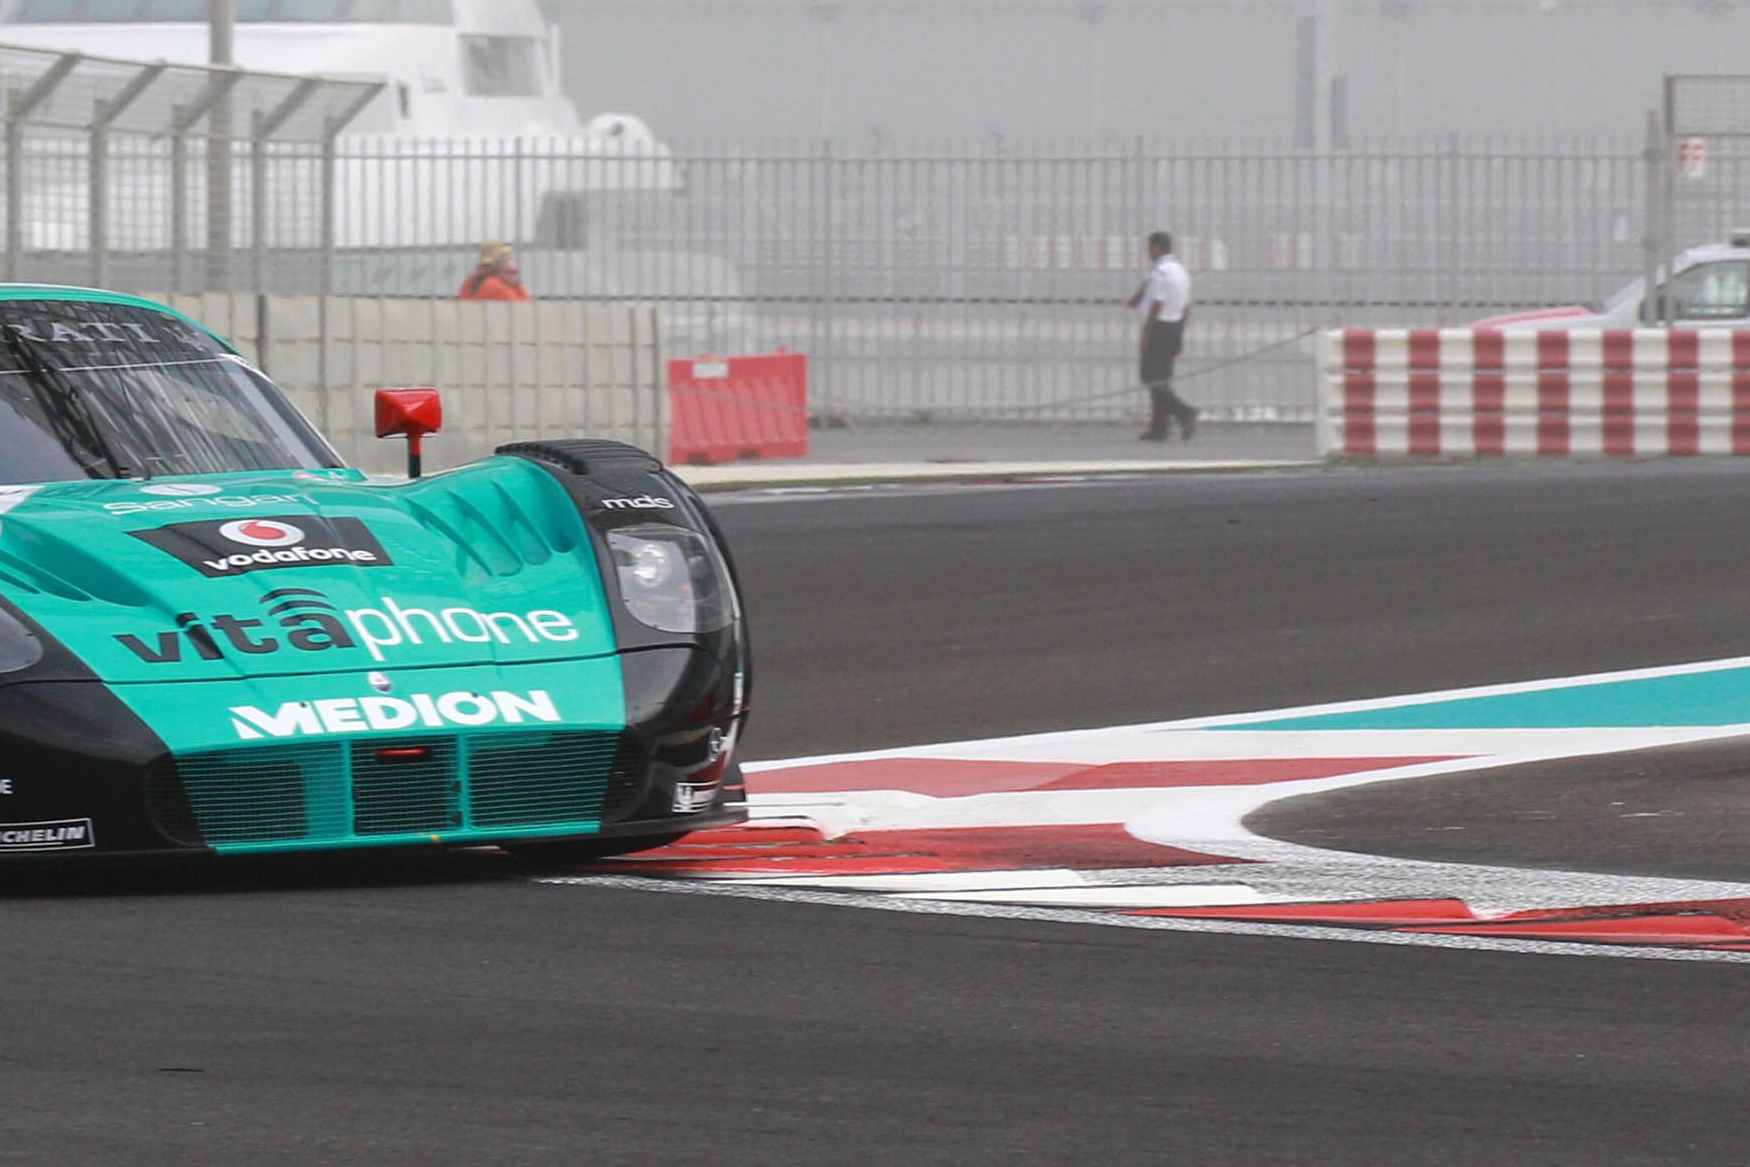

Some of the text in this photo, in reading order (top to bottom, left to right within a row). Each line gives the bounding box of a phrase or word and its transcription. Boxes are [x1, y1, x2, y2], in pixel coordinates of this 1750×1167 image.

[601, 494, 675, 510] mds
[203, 545, 378, 571] vodafone
[114, 596, 580, 663] vitaphone
[229, 689, 562, 740] MEDION
